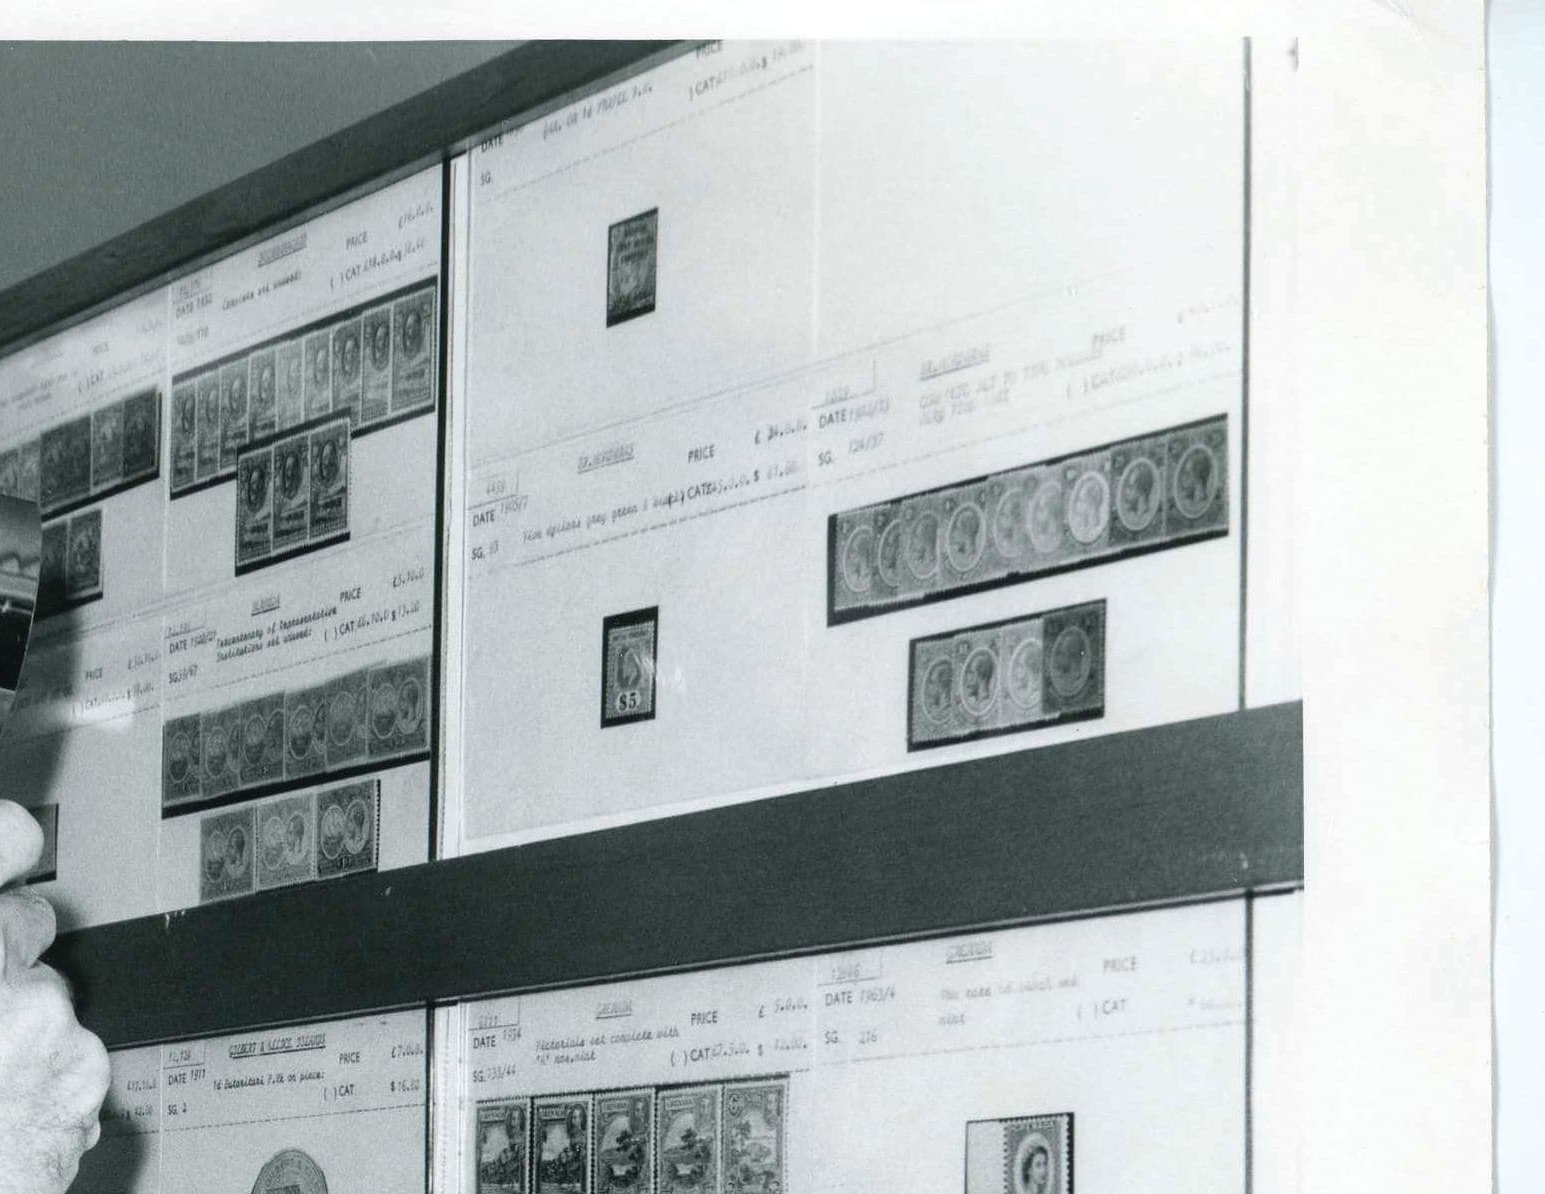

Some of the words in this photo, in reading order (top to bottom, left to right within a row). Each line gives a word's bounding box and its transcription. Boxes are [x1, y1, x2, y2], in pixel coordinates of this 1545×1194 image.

[695, 76, 715, 97] CAT
[346, 231, 368, 250] PRICE
[345, 264, 361, 283] CAT
[176, 301, 194, 319] DATE
[819, 408, 847, 429] DATE
[688, 444, 715, 463] PRICE
[472, 509, 495, 527] DATE
[340, 587, 361, 602] PRICE
[339, 621, 355, 635] CAT
[169, 638, 188, 654] DATE
[825, 991, 853, 1006] DATE
[1102, 998, 1127, 1015] CAT
[691, 1010, 718, 1025] PRICE
[656, 1027, 679, 1039] with
[473, 1035, 496, 1049] DATE
[339, 1051, 361, 1064] PRICE
[690, 1047, 710, 1062] CAT
[168, 1072, 187, 1086] DATE
[338, 1083, 355, 1097] CAT
